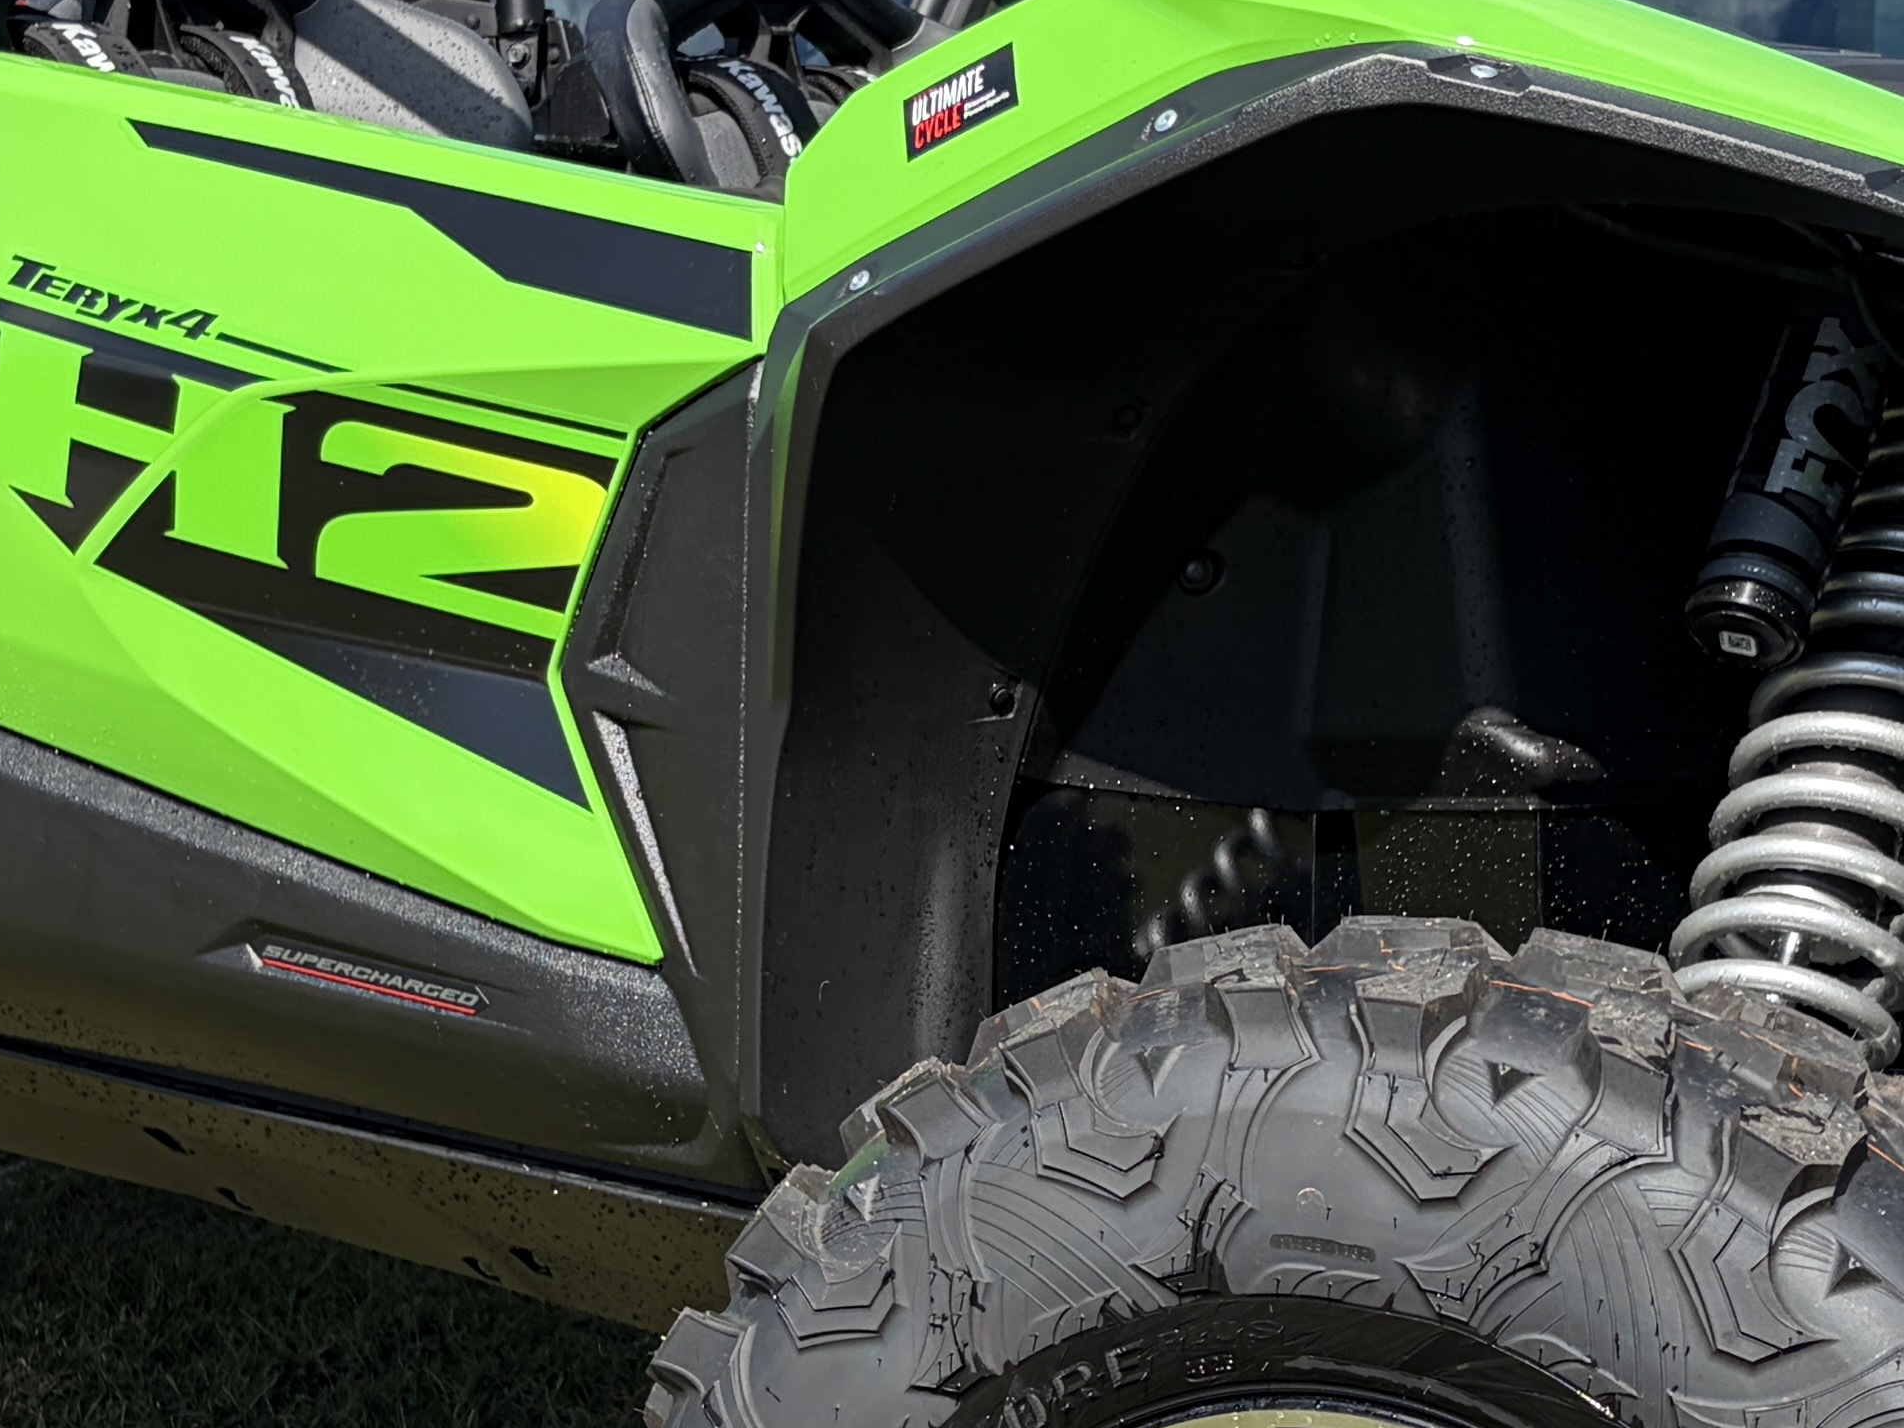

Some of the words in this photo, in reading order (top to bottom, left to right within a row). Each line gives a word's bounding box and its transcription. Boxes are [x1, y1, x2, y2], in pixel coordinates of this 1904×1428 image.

[912, 63, 986, 126] ULTIMATE
[914, 102, 964, 150] CYCLE
[1763, 316, 1888, 521] FOX
[261, 942, 480, 1009] SUPERCHARGED
